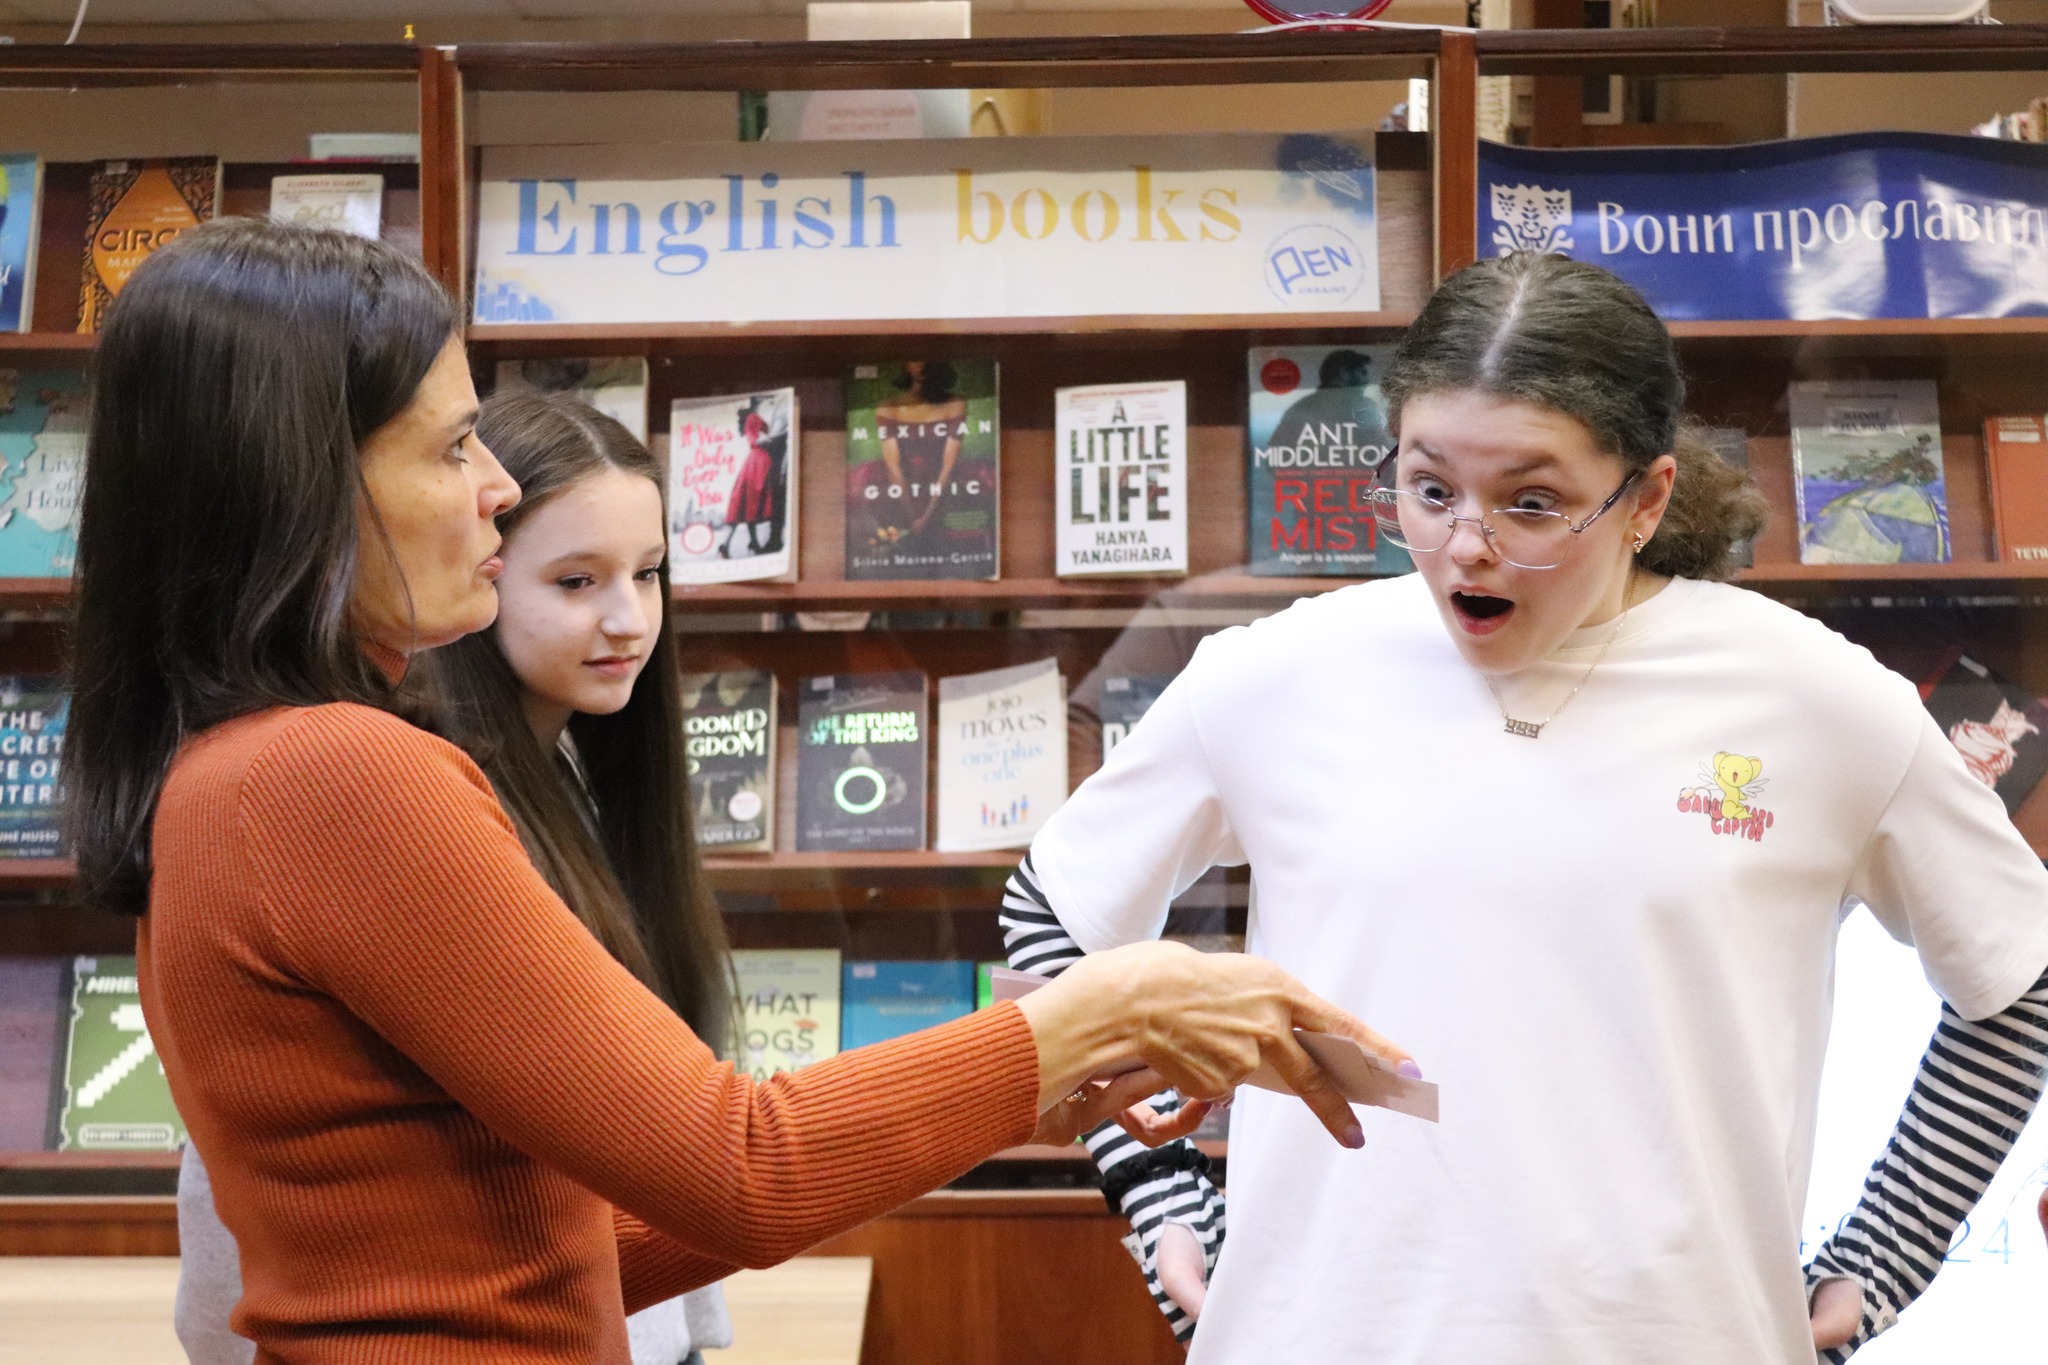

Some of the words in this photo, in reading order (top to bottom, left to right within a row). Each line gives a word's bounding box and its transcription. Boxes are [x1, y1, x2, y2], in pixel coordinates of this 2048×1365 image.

[506, 171, 902, 276] English
[949, 165, 1242, 245] books
[1598, 201, 1736, 255] Вони
[1271, 245, 1353, 295] PEN
[1111, 400, 1127, 424] A
[697, 424, 735, 445] Was
[852, 419, 992, 441] MEXICAN
[1296, 422, 1358, 446] ANT
[1070, 424, 1169, 464] LITTLE
[864, 480, 981, 500] GOTHIC
[1071, 463, 1170, 525] LIFE
[1096, 530, 1148, 546] HANYA
[1271, 516, 1377, 551] MIST
[1072, 547, 1173, 565] YANAGIHARA
[684, 708, 768, 735] OOKED
[845, 711, 915, 729] RETURN
[834, 729, 867, 744] THE
[871, 727, 919, 743] KING
[86, 975, 139, 994] MINE
